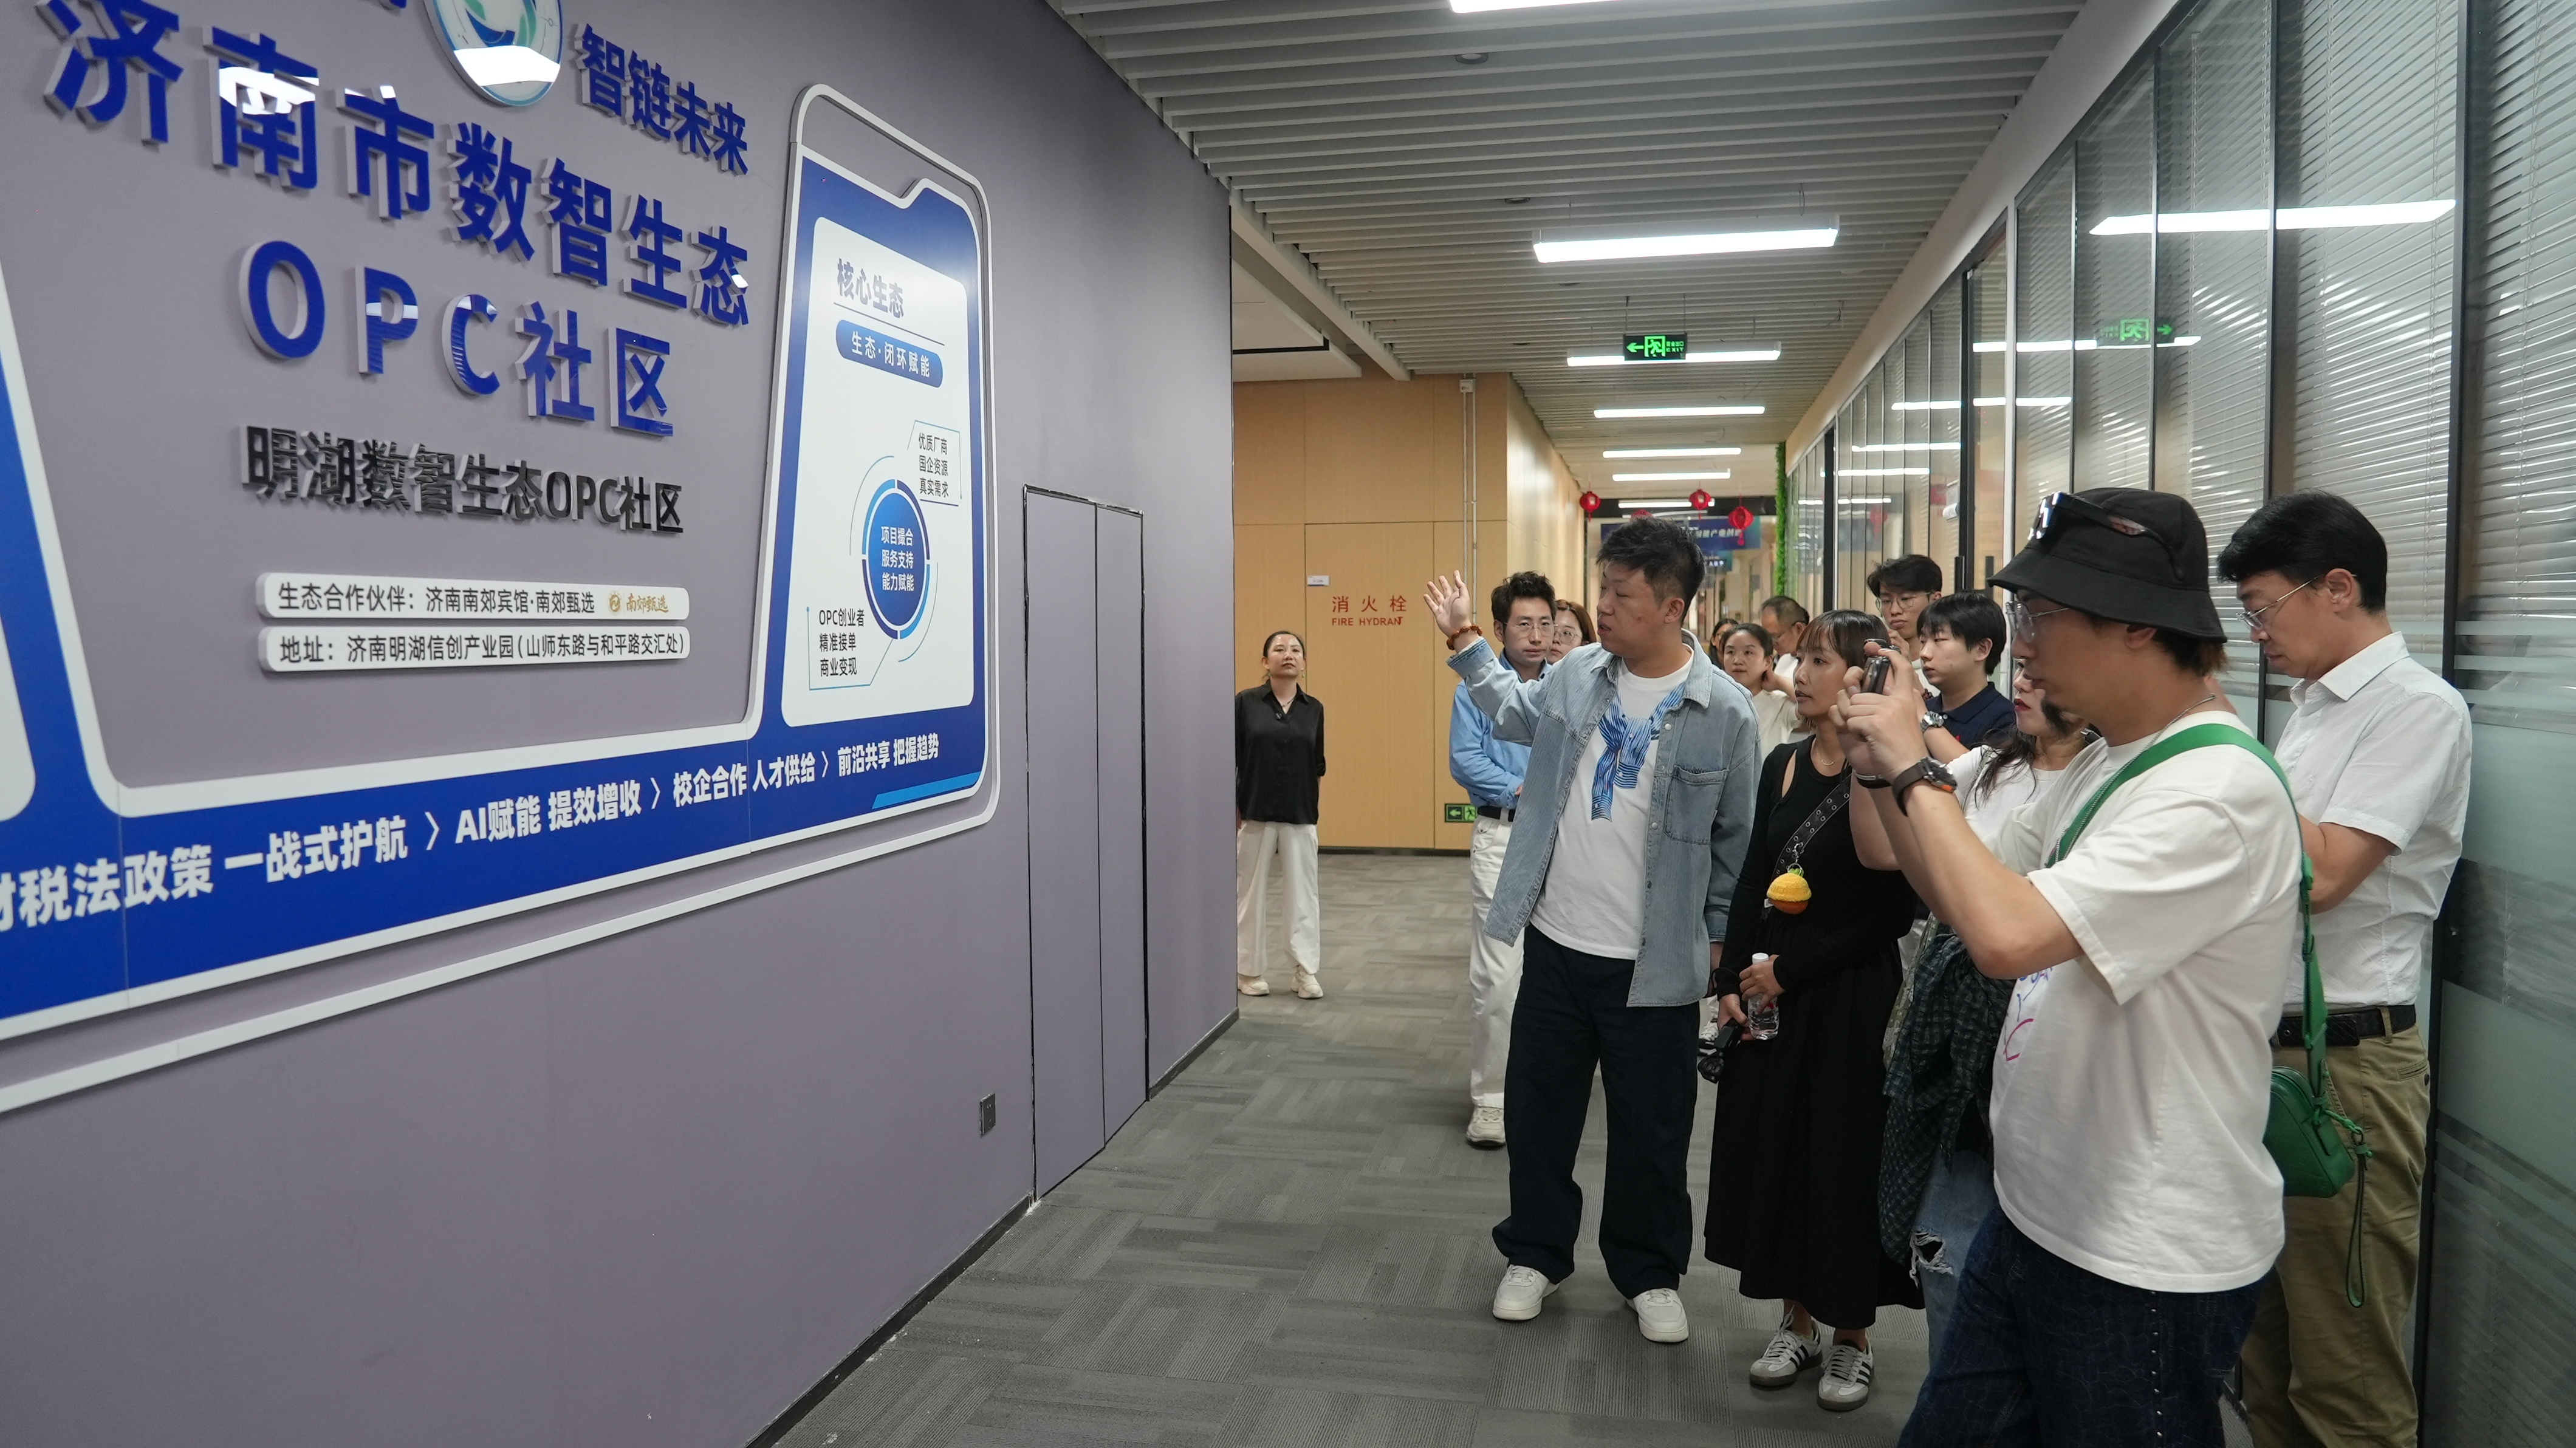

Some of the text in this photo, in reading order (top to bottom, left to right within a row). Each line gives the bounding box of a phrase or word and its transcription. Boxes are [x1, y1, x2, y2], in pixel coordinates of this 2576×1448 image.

[576, 23, 748, 175] 智链未来
[40, 0, 750, 325] 济南市数智生态
[837, 258, 904, 318] 核心生态
[241, 241, 674, 436] OPC社区
[851, 330, 930, 378] 生态·闭环赋能
[919, 432, 948, 456] 优质厂商
[919, 455, 948, 476] 国企资源
[244, 426, 683, 533] 明湖数智生态OPC社区
[919, 477, 949, 498] 真实需求
[881, 526, 914, 547] 项目撮合
[882, 549, 914, 570] 服务支持
[882, 572, 914, 592] 能力赋能
[1332, 595, 1406, 612] 消火栓
[819, 607, 865, 627] OPC创业者
[1359, 616, 1403, 626] HYDRANT
[819, 633, 857, 652] 精准接单
[820, 657, 857, 677] 商业变现
[0, 732, 939, 932] 税法政策 一战式护航 AI赋能 提效增收 校企合作 人才供给 前沿共享 把握趋势
